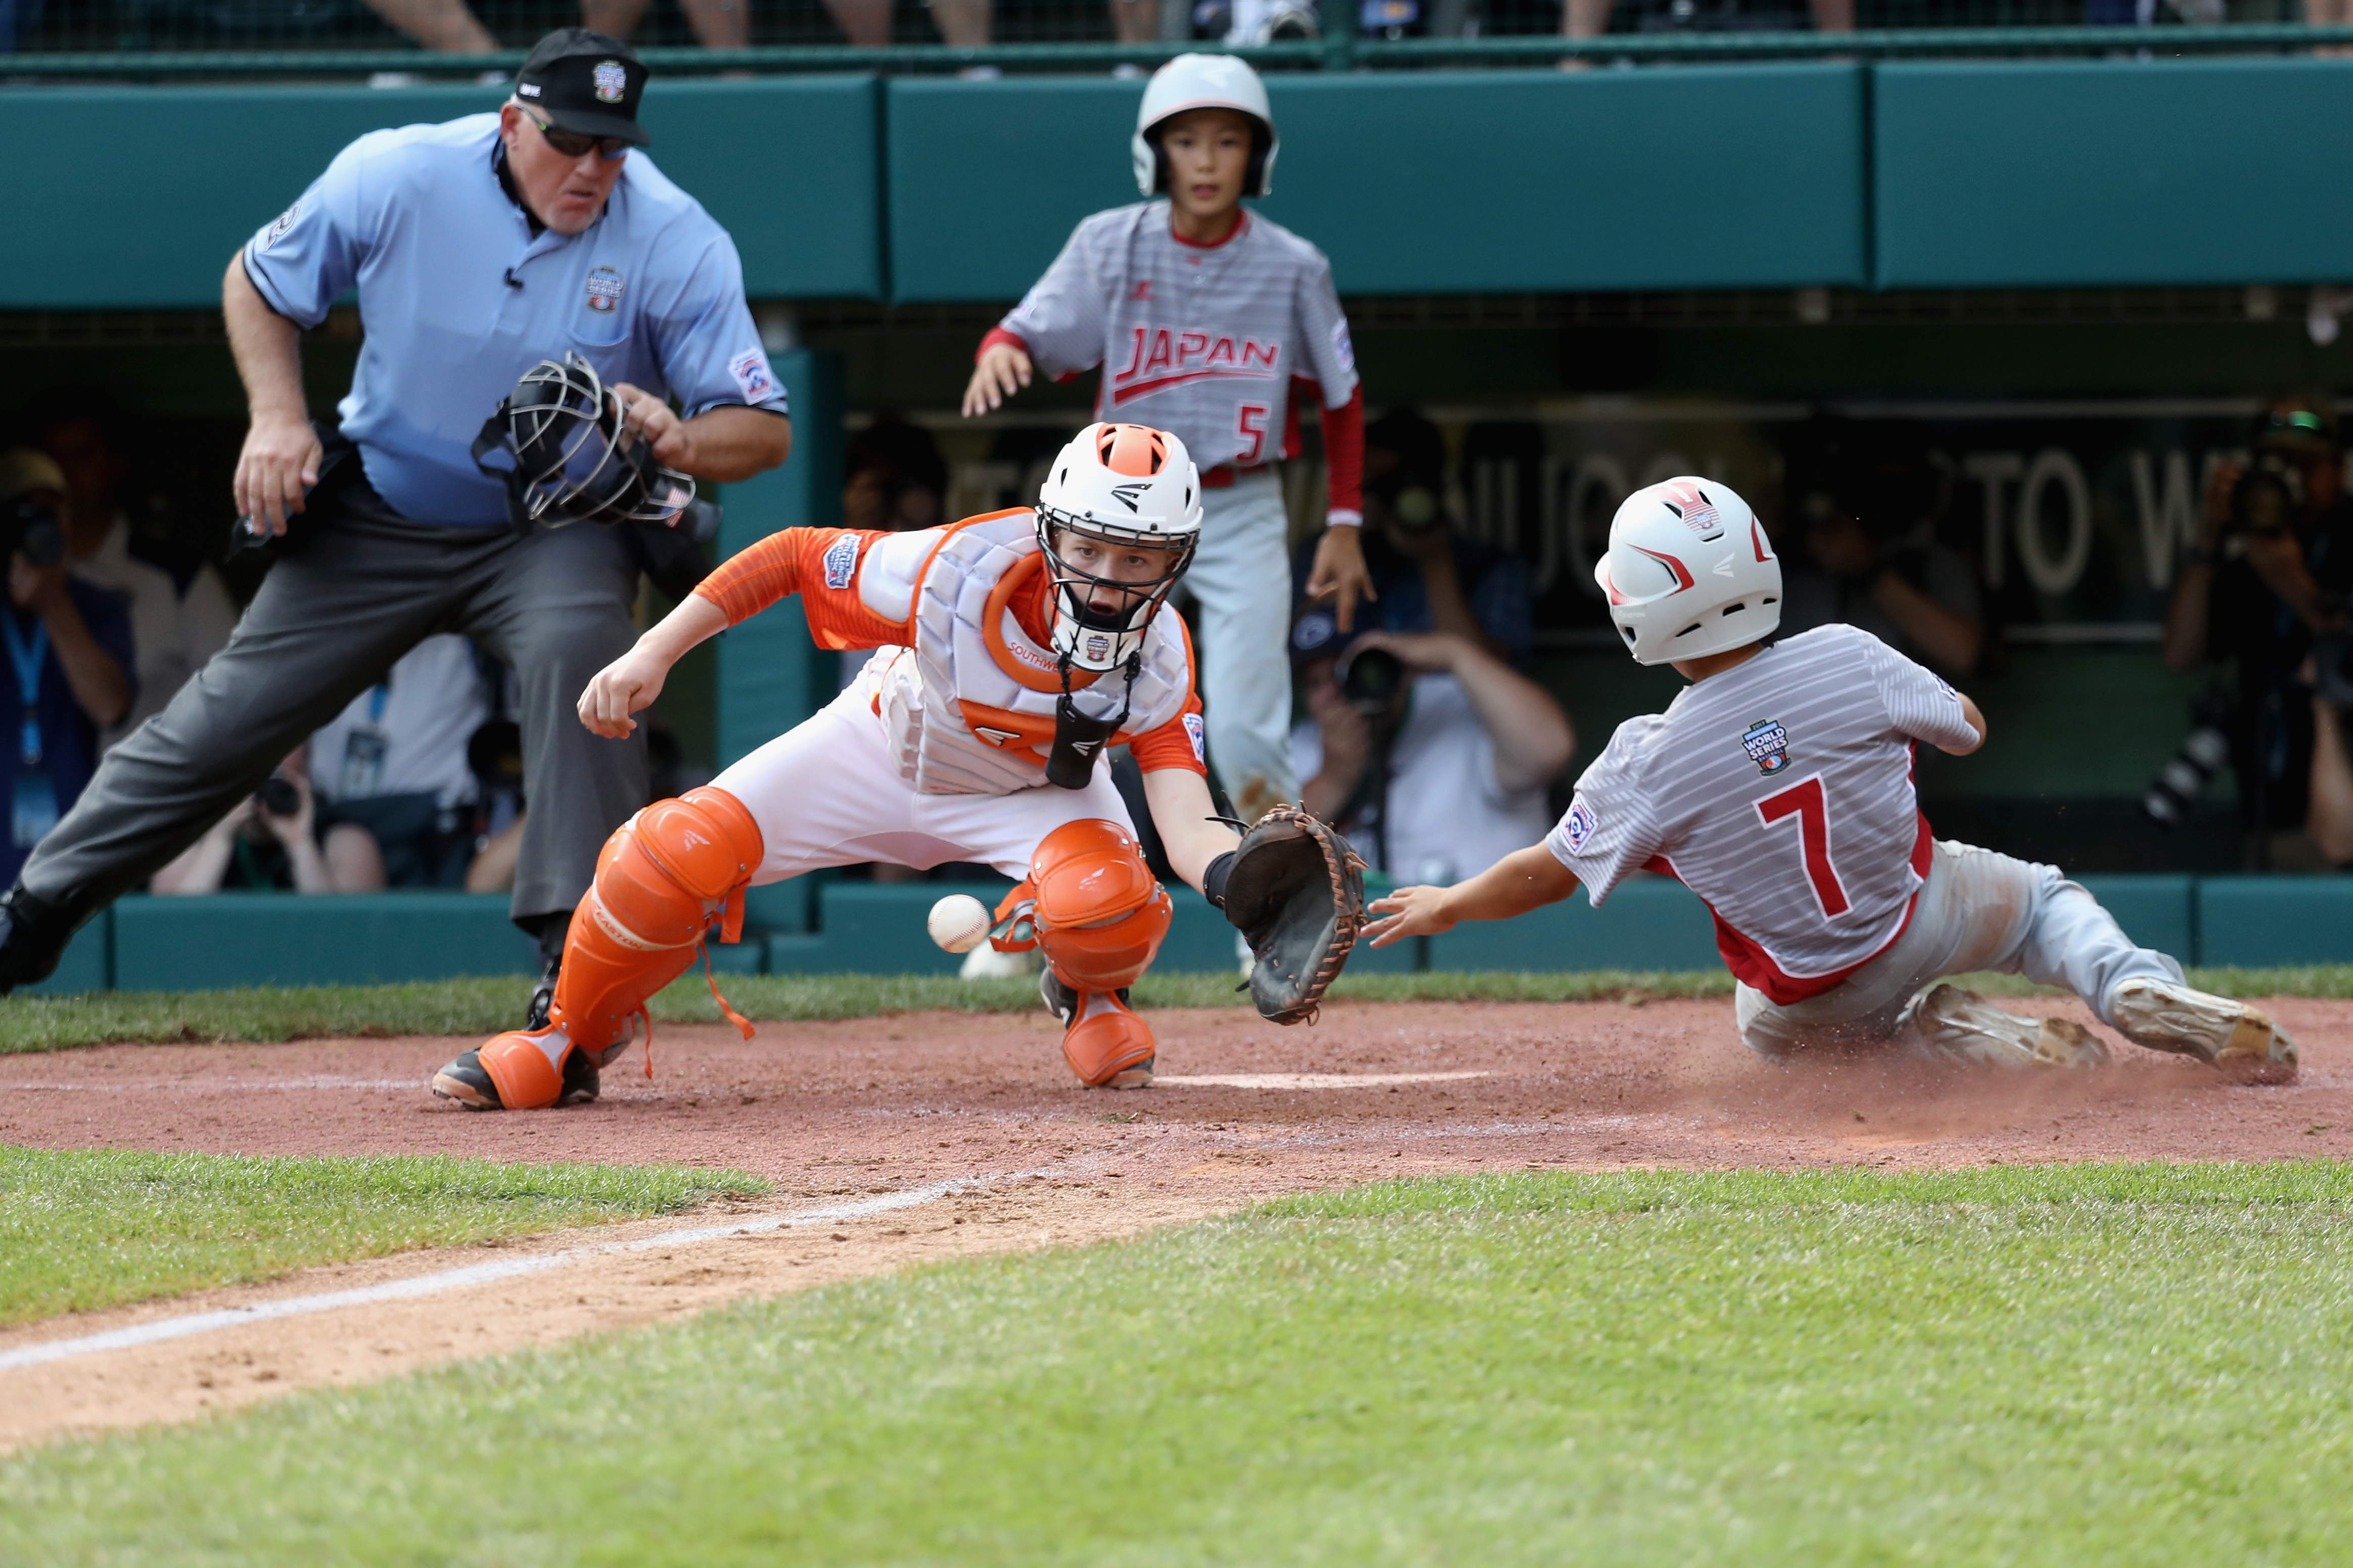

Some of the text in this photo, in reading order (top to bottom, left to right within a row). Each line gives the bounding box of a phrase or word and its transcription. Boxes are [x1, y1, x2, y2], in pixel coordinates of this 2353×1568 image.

[1112, 322, 1281, 386] JAPAN
[1234, 403, 1270, 463] 5
[1744, 728, 1785, 750] WORLD
[1749, 737, 1787, 759] SERIES
[1753, 772, 1852, 922] 7
[596, 912, 642, 949] EASTON
